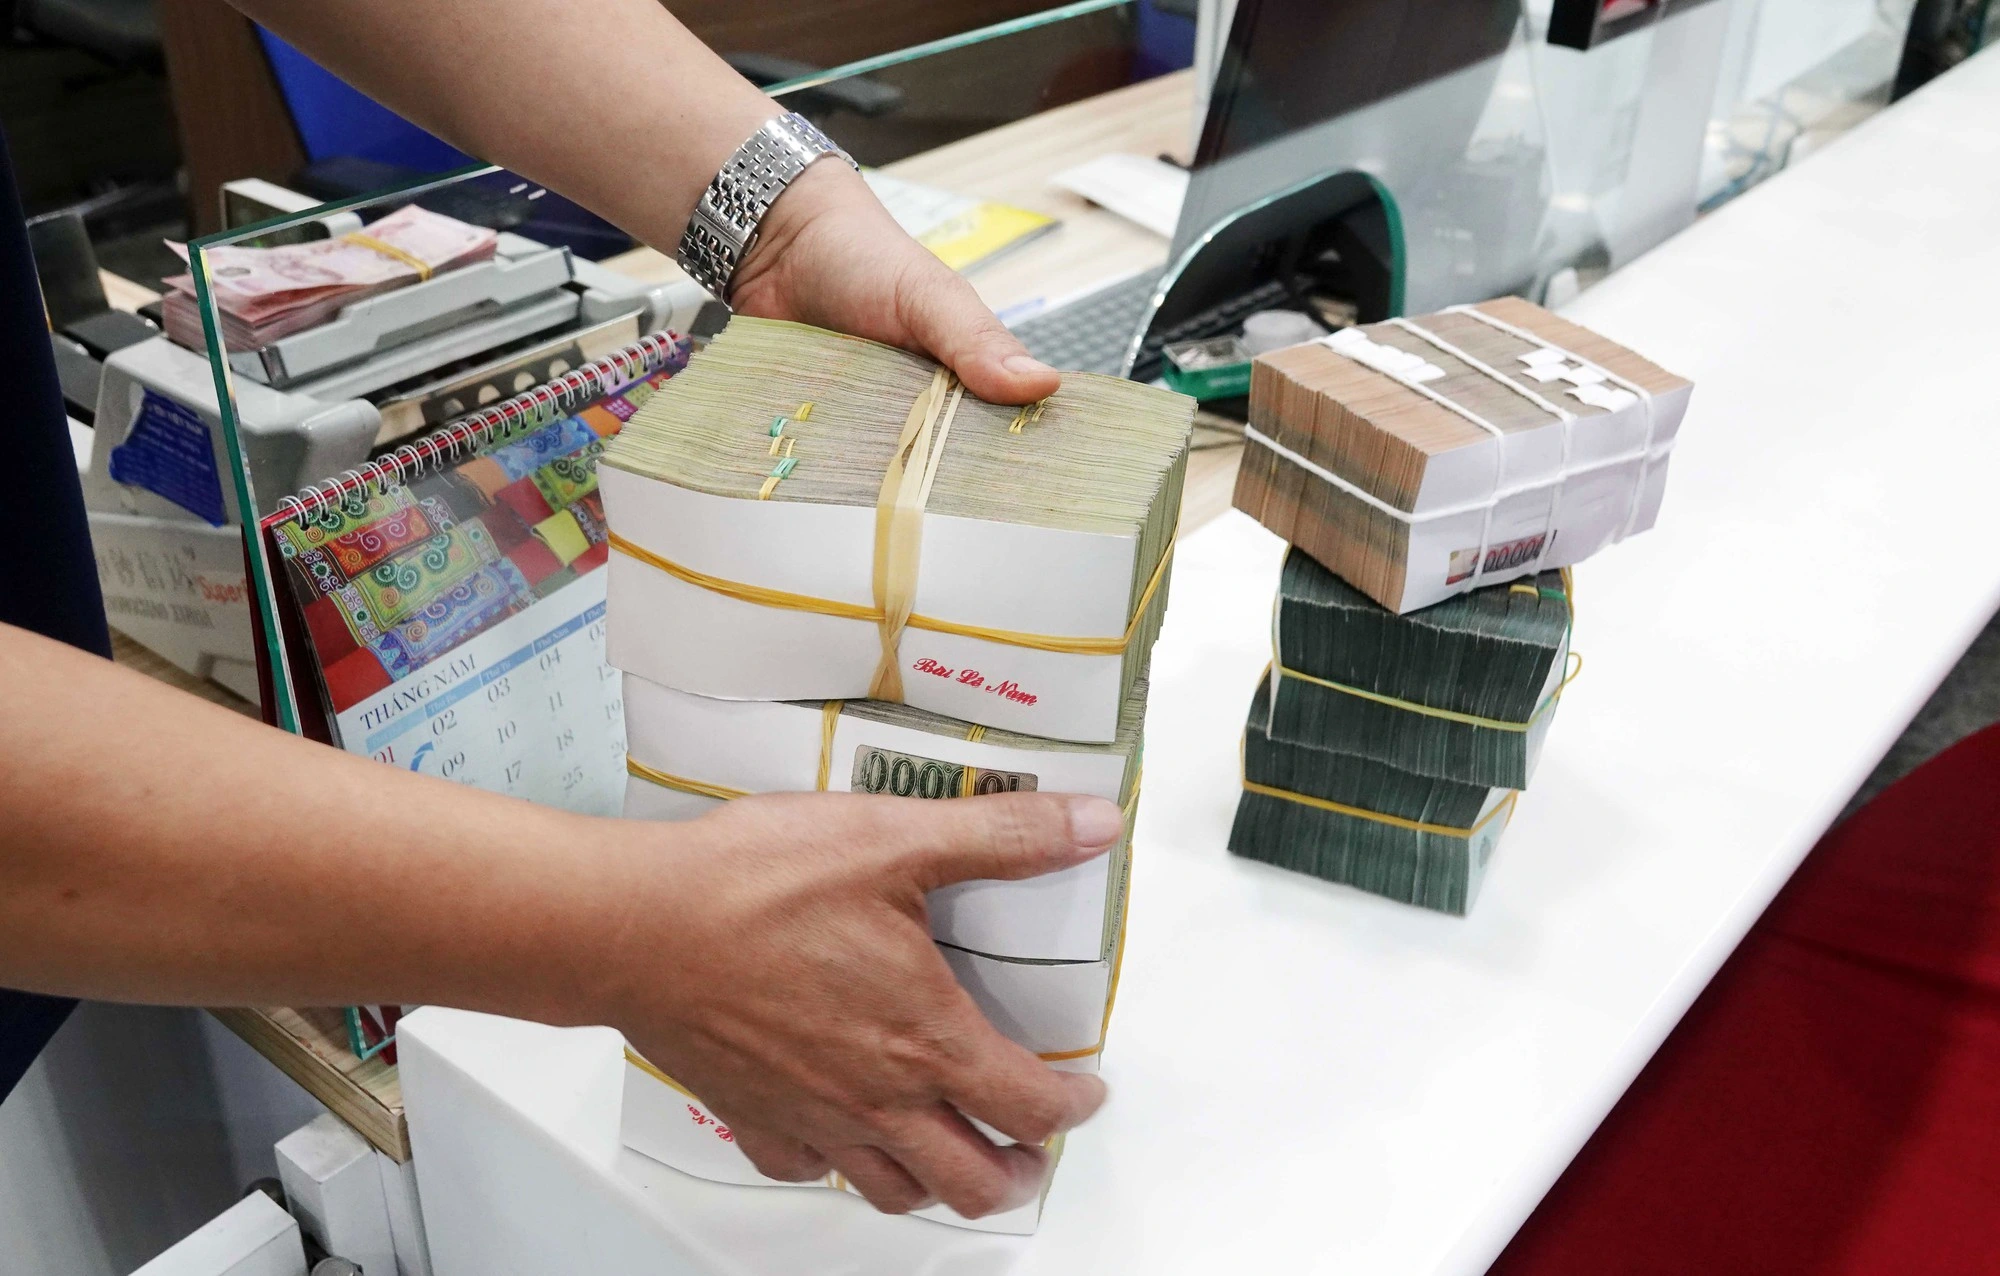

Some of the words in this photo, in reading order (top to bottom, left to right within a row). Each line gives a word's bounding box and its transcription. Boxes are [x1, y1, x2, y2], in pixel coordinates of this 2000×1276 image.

[359, 680, 431, 730] THÁNG
[373, 745, 396, 764] 01
[432, 708, 458, 737] 02
[487, 677, 511, 703] 03
[539, 646, 561, 672] 04
[442, 751, 466, 778] 09
[497, 720, 517, 744] 10
[549, 691, 563, 713] 11
[505, 760, 522, 783] 17
[556, 728, 575, 752] 18
[562, 766, 584, 791] 25
